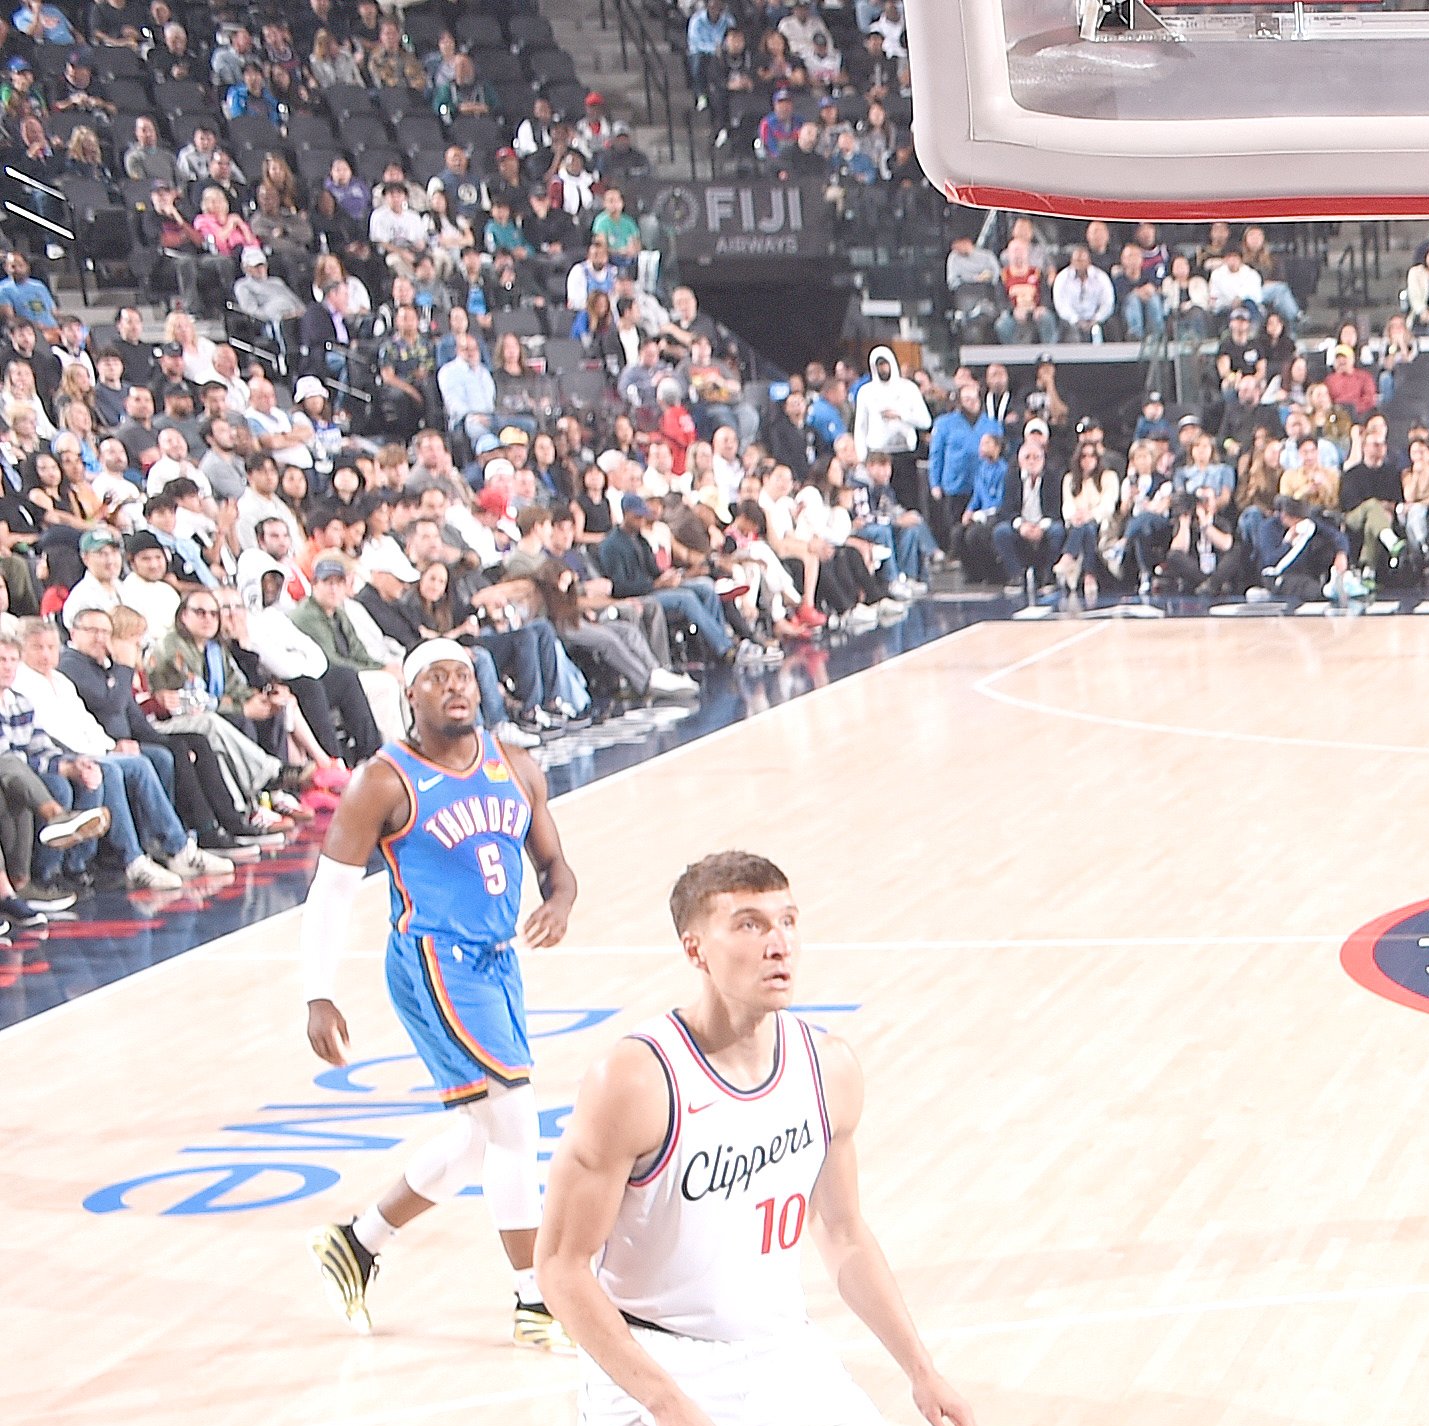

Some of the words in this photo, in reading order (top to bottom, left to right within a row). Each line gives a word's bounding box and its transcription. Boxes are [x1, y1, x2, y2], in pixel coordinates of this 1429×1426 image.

[704, 186, 803, 233] FIJI
[475, 841, 508, 896] 5
[681, 1118, 814, 1202] Clippers
[755, 1193, 806, 1255] 10
